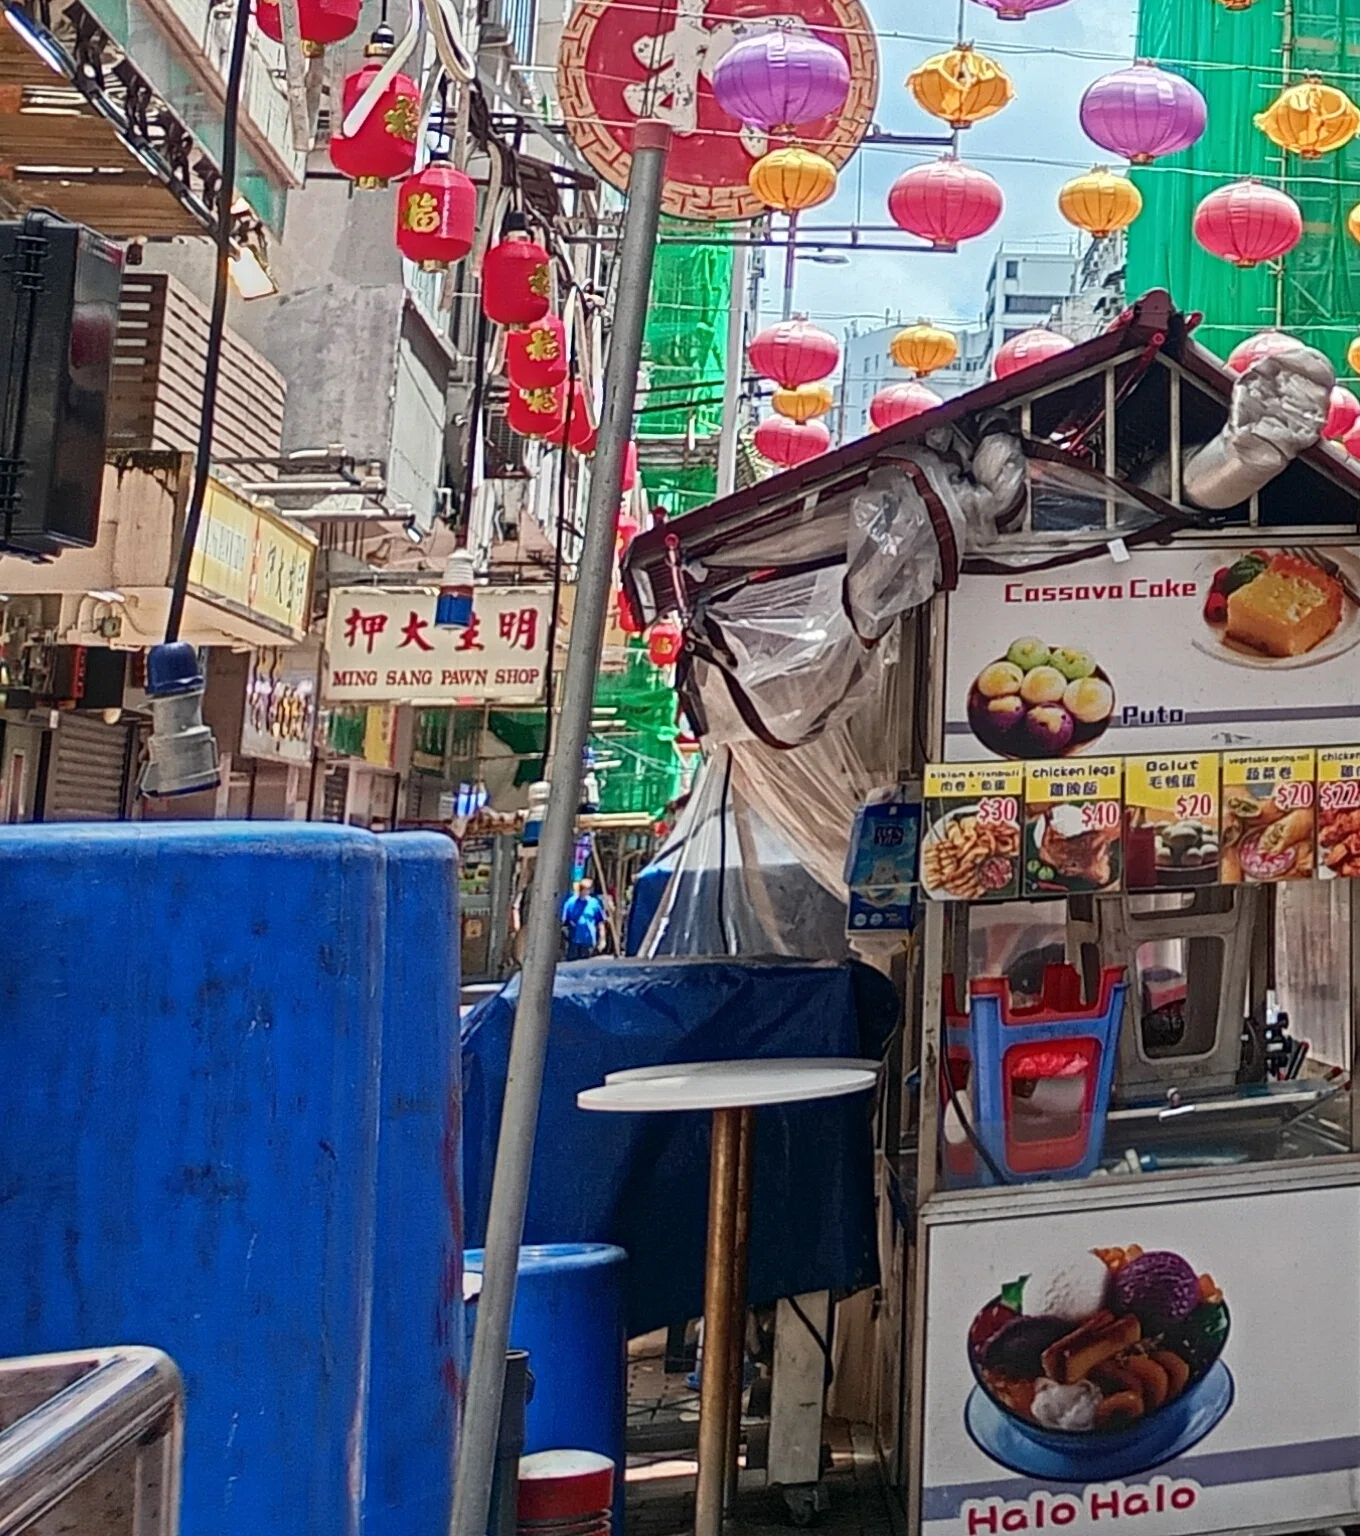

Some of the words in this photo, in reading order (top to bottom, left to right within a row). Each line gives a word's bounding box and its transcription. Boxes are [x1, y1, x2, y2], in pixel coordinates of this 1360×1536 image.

[1004, 583, 1123, 603] Cassava
[1130, 579, 1197, 599] Cake
[332, 669, 379, 688] MING
[385, 668, 433, 687] SANG
[440, 668, 488, 686] PAWN
[494, 667, 541, 686] SHOP
[1121, 704, 1186, 726] Puto
[1032, 766, 1087, 779] chicken
[1088, 764, 1117, 777] legs
[1146, 759, 1199, 772] Balut
[1176, 794, 1212, 817] $20
[1277, 782, 1313, 808] $20
[1320, 783, 1359, 808] $22
[978, 799, 1017, 823] $30
[1081, 803, 1118, 827] $40
[967, 1498, 1077, 1536] Halo
[1090, 1484, 1197, 1522] Halo
